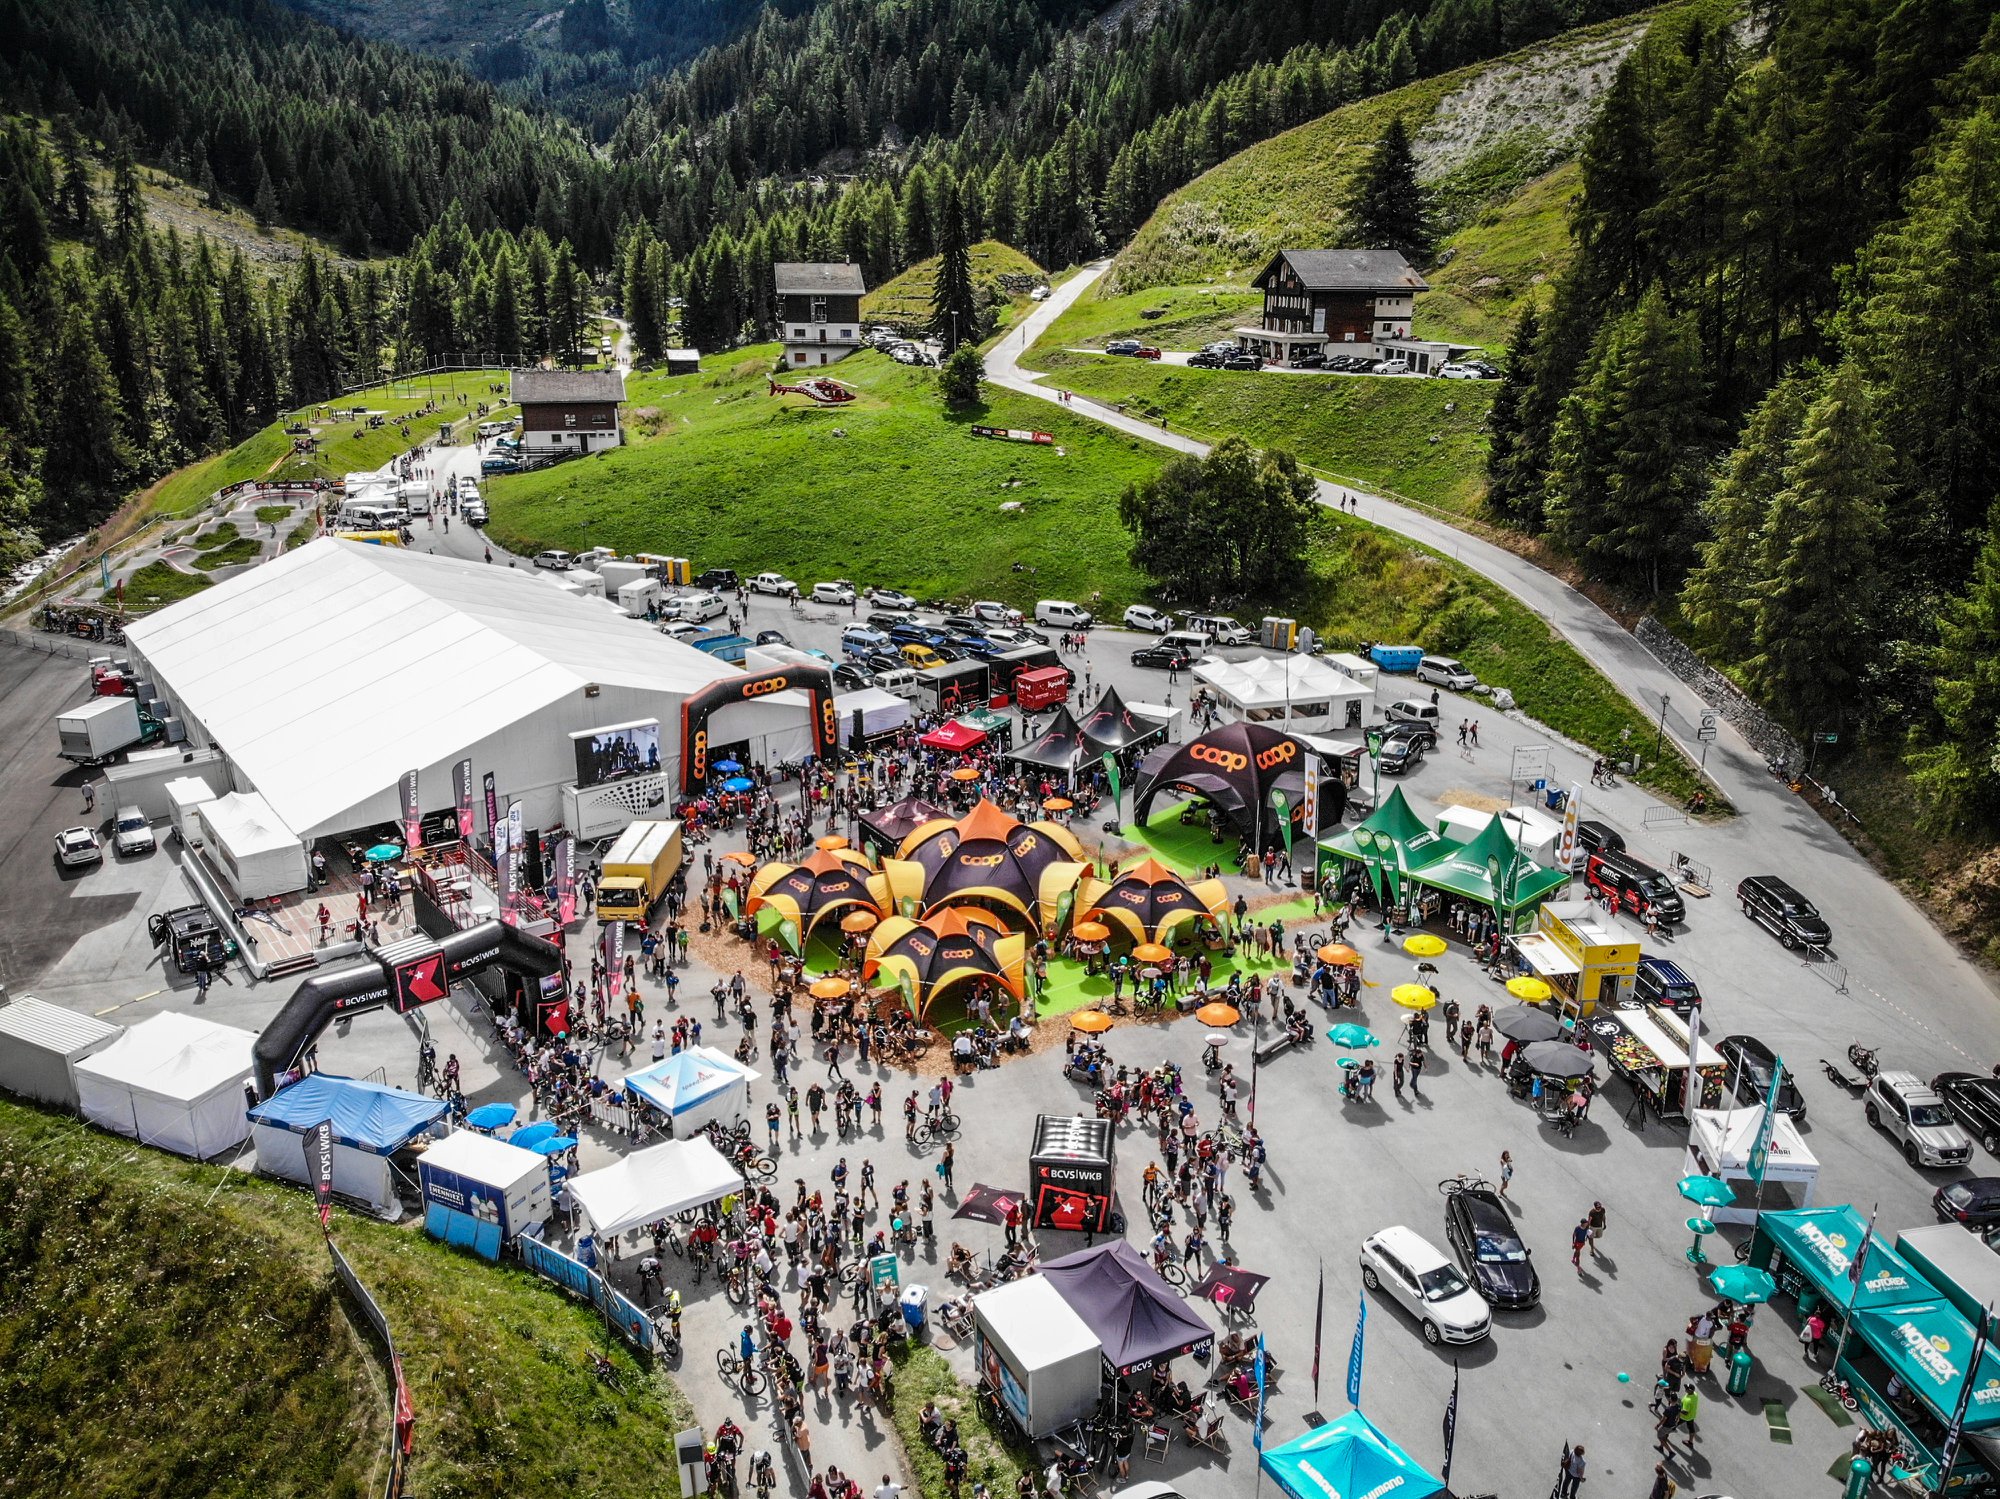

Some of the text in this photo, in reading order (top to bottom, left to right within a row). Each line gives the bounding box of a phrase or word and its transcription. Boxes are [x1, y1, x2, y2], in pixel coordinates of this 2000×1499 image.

[742, 676, 787, 696] coop
[823, 698, 836, 745] coop
[693, 730, 707, 779] coop
[1190, 743, 1248, 773] coop
[1256, 741, 1296, 770] coop
[1176, 783, 1198, 793] coop
[938, 837, 953, 858] coop
[1014, 835, 1036, 858] coop
[960, 854, 1004, 867] coop
[1600, 865, 1621, 881] BMC
[788, 878, 809, 893] coop
[820, 881, 850, 893] coop
[1119, 890, 1146, 904] coop
[1156, 892, 1182, 904] coop
[909, 937, 931, 956] coop
[942, 948, 974, 959] coop
[1797, 1221, 1853, 1273] MOTOREX
[1864, 1277, 1908, 1290] MOTOREX
[1130, 1338, 1211, 1374] BCVS WKB
[1891, 1329, 1903, 1340] Oil
[1900, 1340, 1911, 1348] of
[1908, 1348, 1947, 1386] Switzerland
[1897, 1321, 1960, 1381] MOTOREX
[1973, 1387, 2000, 1401] MOTO
